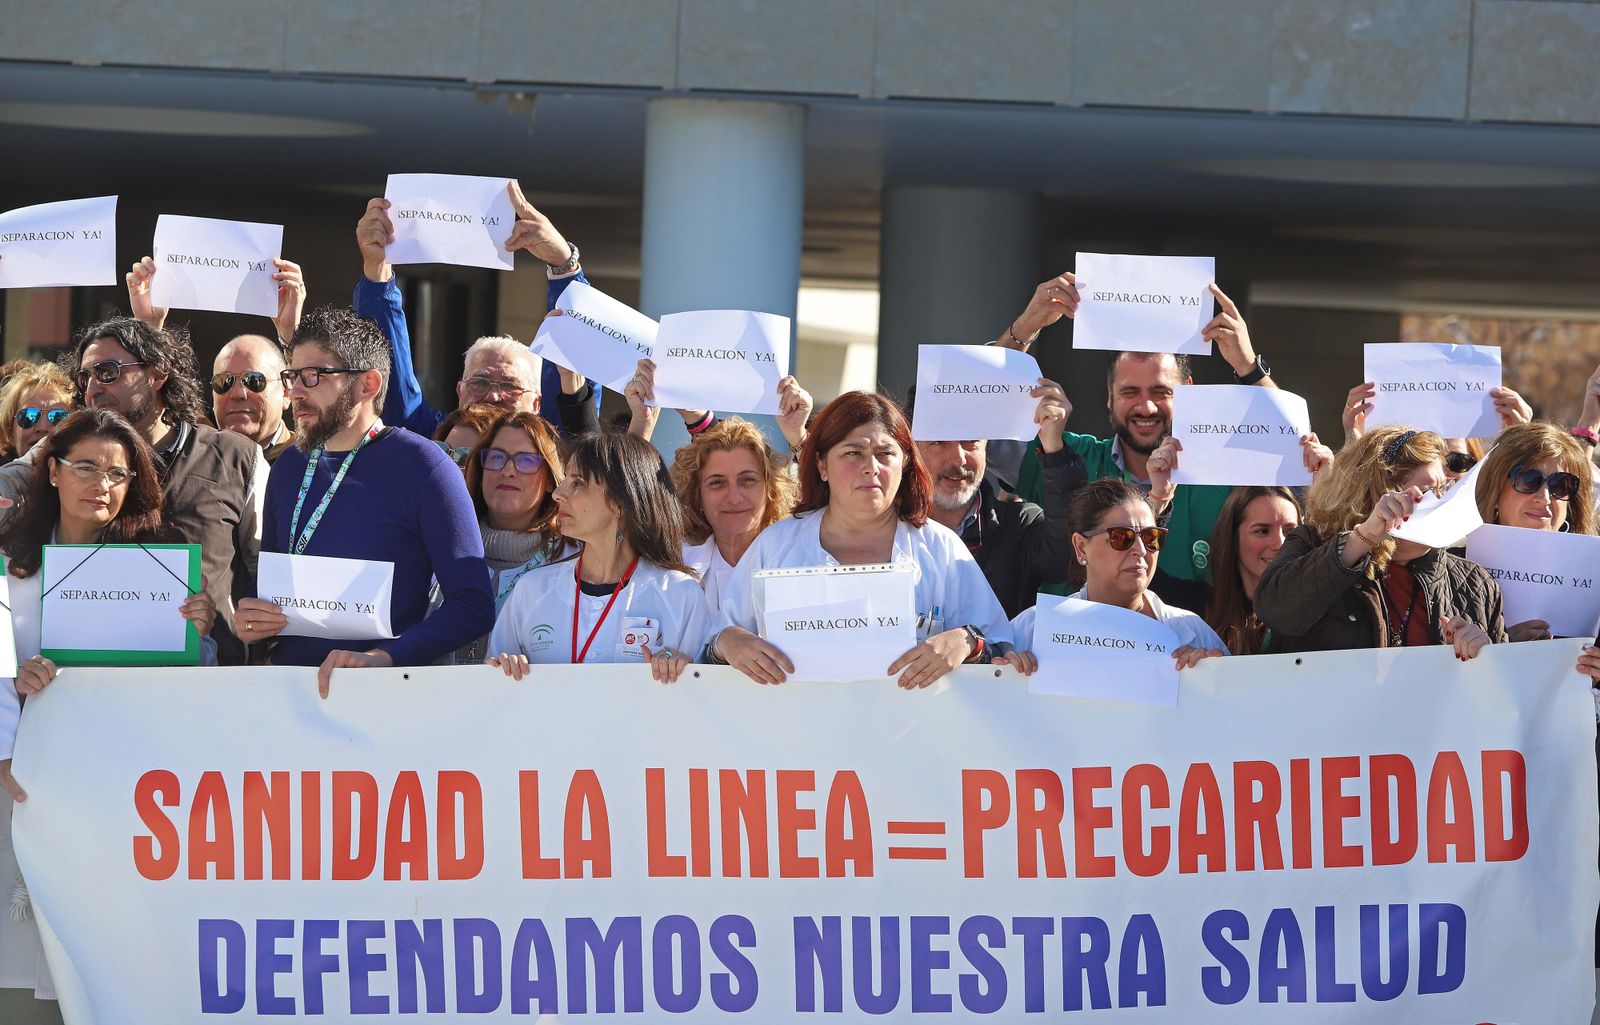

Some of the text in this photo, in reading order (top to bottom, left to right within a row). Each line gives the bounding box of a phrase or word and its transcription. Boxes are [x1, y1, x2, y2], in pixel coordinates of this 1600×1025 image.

[397, 210, 499, 226] ¡SEPARACION YA!
[1, 230, 102, 242] ¡SEPARACION YA!
[167, 253, 266, 271] ¡SEPARACION YA!
[1093, 291, 1200, 306] ¡SEPARACION YA!
[666, 347, 775, 362] ¡SEPARACION YA!
[933, 384, 1010, 394] ¡SEPARACION
[1379, 382, 1485, 392] ¡SEPARACION YA!
[1190, 424, 1298, 435] ¡SEPARACION YA!
[1572, 577, 1592, 589] YA!
[60, 590, 170, 602] ¡SEPARACION YA!
[271, 596, 376, 614] ¡SEPARACION YA!
[784, 616, 899, 632] ¡SEPARACION YA!
[1052, 633, 1166, 653] ¡SEPARACION YA!
[133, 770, 485, 881] SANIDAD
[520, 769, 612, 880] LA
[961, 750, 1530, 879] PRECARIEDAD
[197, 902, 1468, 1017] DEFENDAMOS NUESTRA SALUD
